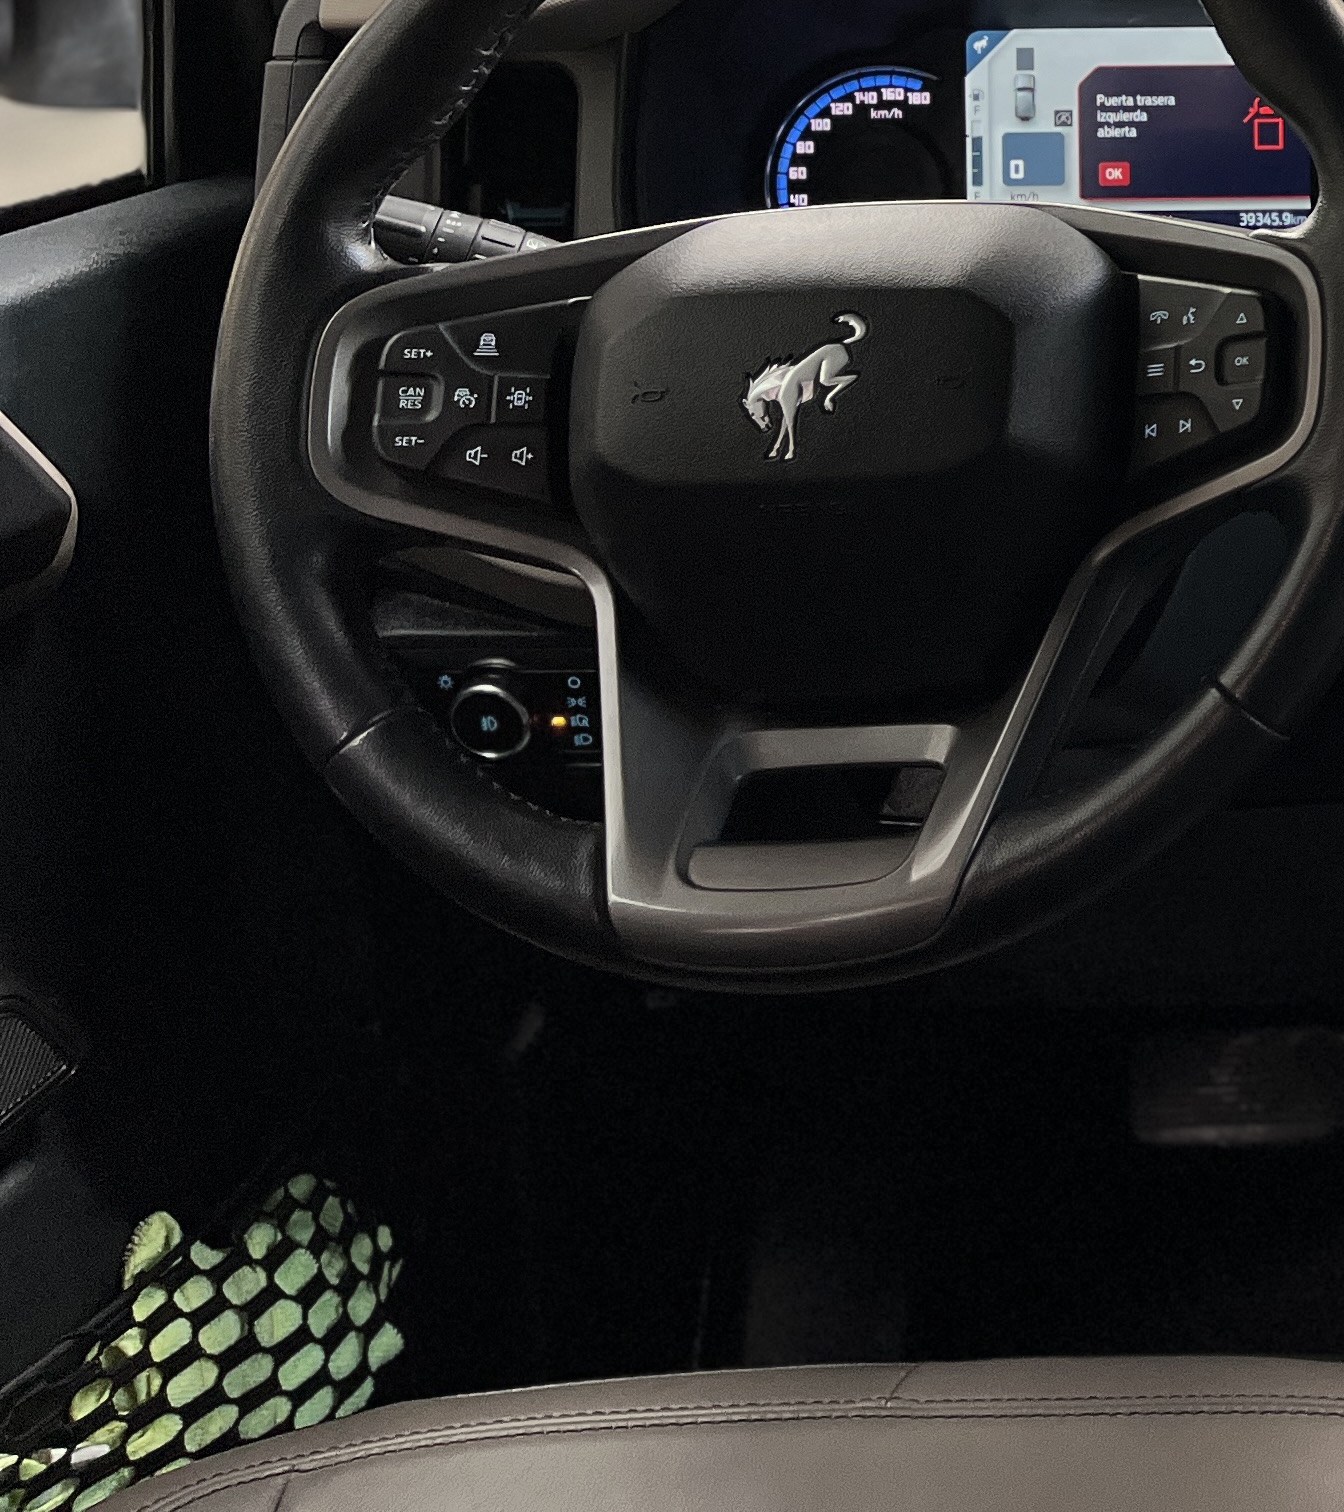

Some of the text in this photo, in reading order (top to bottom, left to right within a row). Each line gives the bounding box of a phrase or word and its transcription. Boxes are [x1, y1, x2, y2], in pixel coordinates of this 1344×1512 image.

[854, 91, 878, 105] 140
[881, 88, 905, 101] 160
[907, 91, 931, 105] 180
[1096, 93, 1176, 106] Puerta trasera
[830, 102, 853, 116] 120
[870, 107, 903, 120] km/h
[810, 118, 832, 132] 100
[1096, 125, 1137, 138] abierta
[796, 140, 815, 154] 80
[788, 166, 807, 180] 60
[1009, 158, 1025, 180] 0
[1105, 168, 1123, 180] OK
[789, 194, 808, 206] 40
[1010, 191, 1039, 202] km/h
[403, 348, 434, 360] SET+
[1234, 356, 1249, 367] OK
[398, 386, 425, 397] CAN
[398, 399, 422, 409] RES
